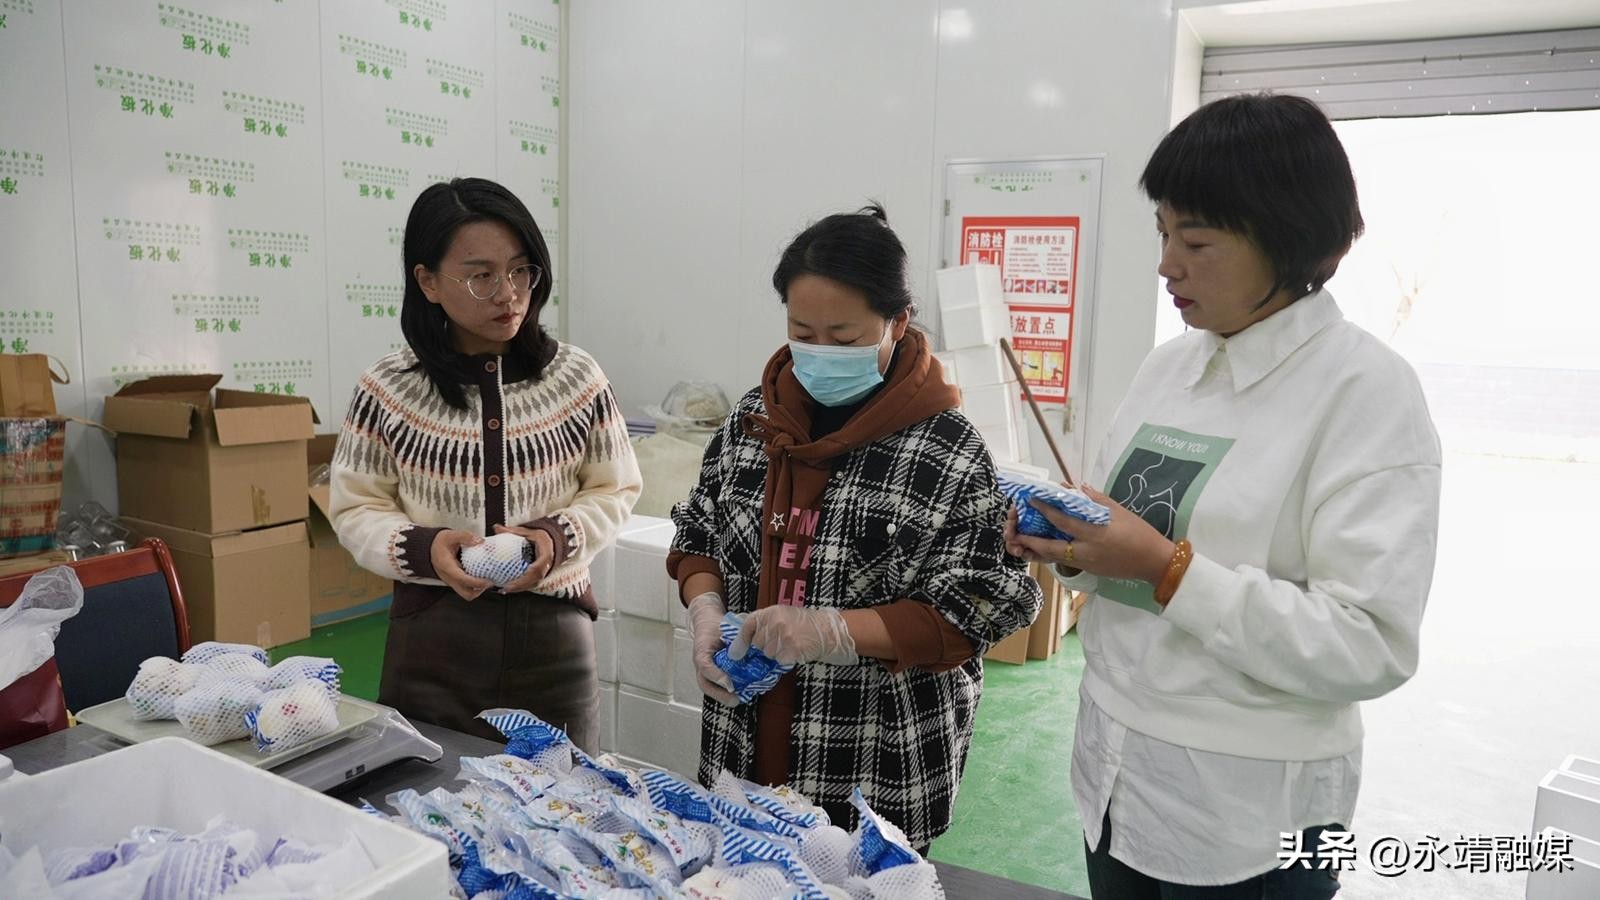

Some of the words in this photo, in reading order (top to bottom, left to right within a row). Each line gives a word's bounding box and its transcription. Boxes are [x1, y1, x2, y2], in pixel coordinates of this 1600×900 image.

[120, 95, 174, 118] 净化板
[968, 232, 1003, 248] 消防栓
[128, 244, 181, 262] 净化板
[195, 318, 242, 333] 净化板
[1010, 315, 1055, 334] 放置点
[1155, 433, 1188, 450] KNOW
